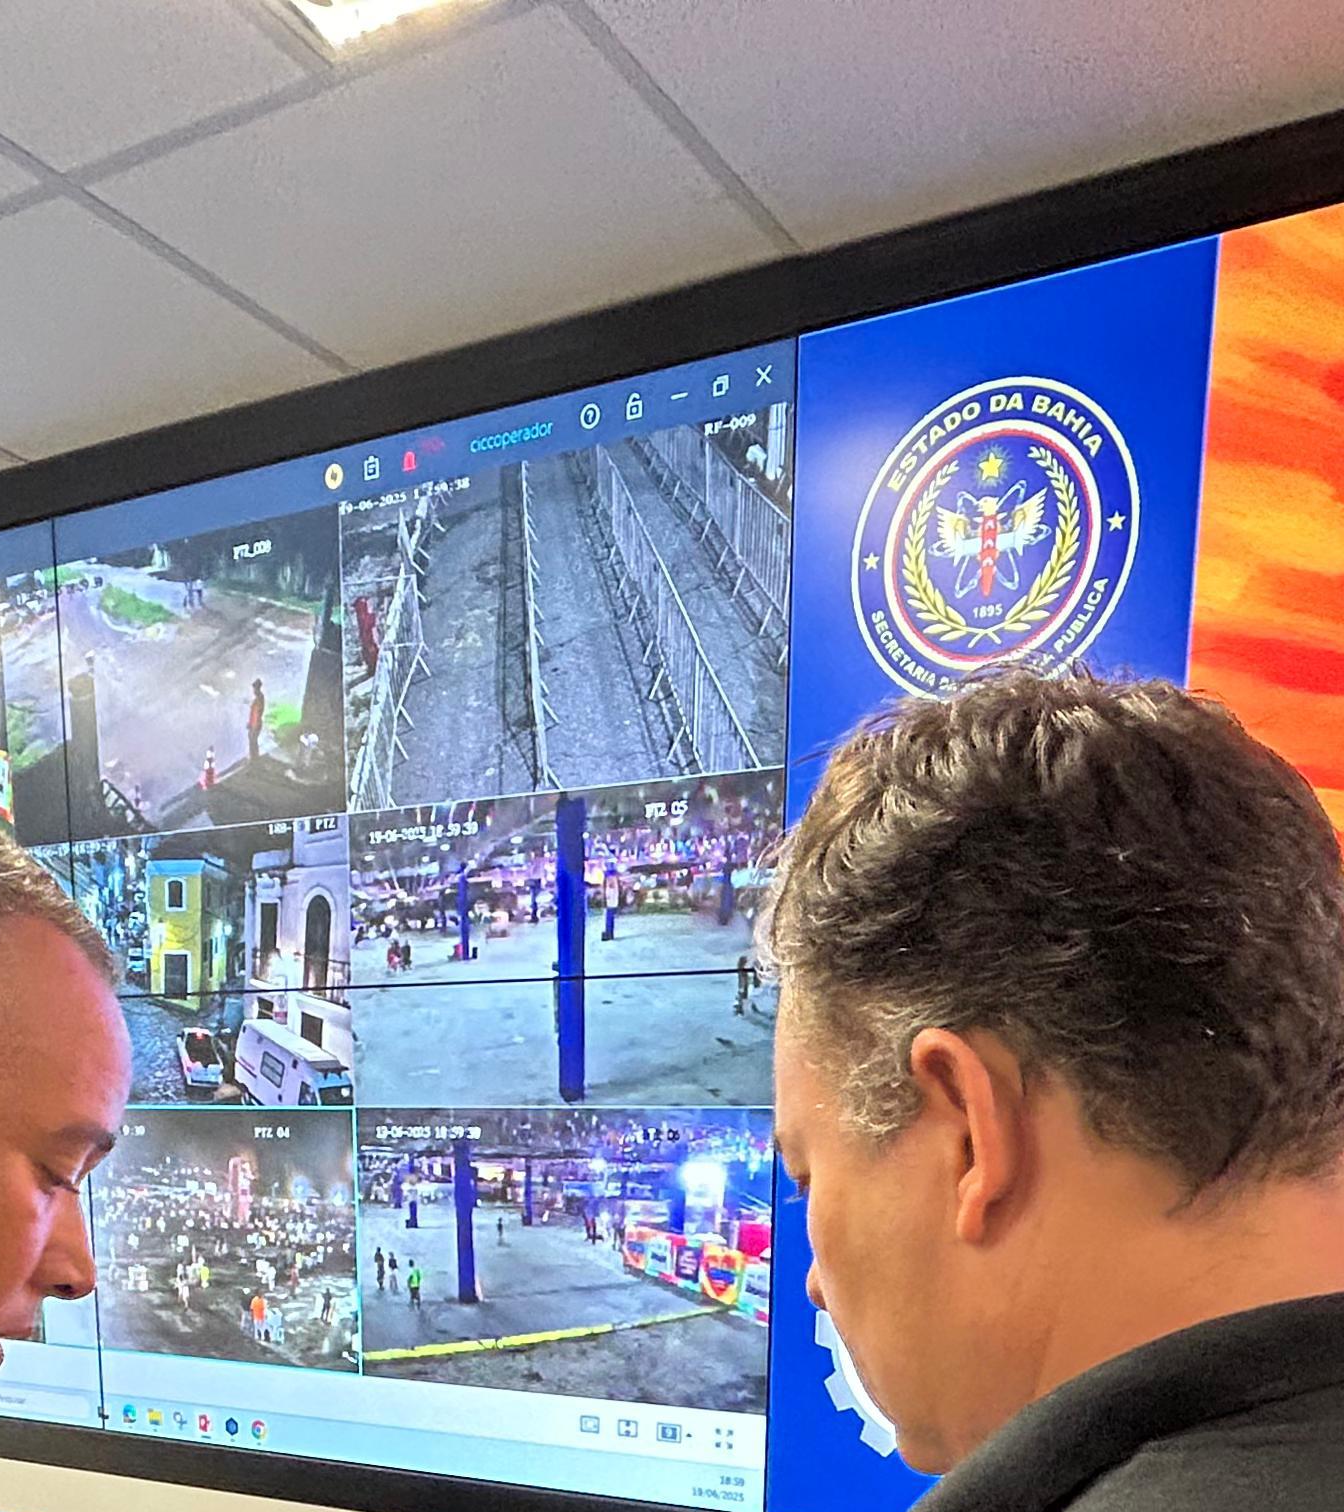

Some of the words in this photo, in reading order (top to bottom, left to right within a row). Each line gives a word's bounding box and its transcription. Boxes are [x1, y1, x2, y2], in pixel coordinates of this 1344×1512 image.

[887, 402, 982, 493] ESTADO
[989, 392, 1024, 413] DA
[1031, 393, 1104, 456] BAHIA
[871, 608, 937, 687] SECRETARIA
[972, 601, 1004, 619] 1895
[1053, 578, 1109, 653] PUBLICA
